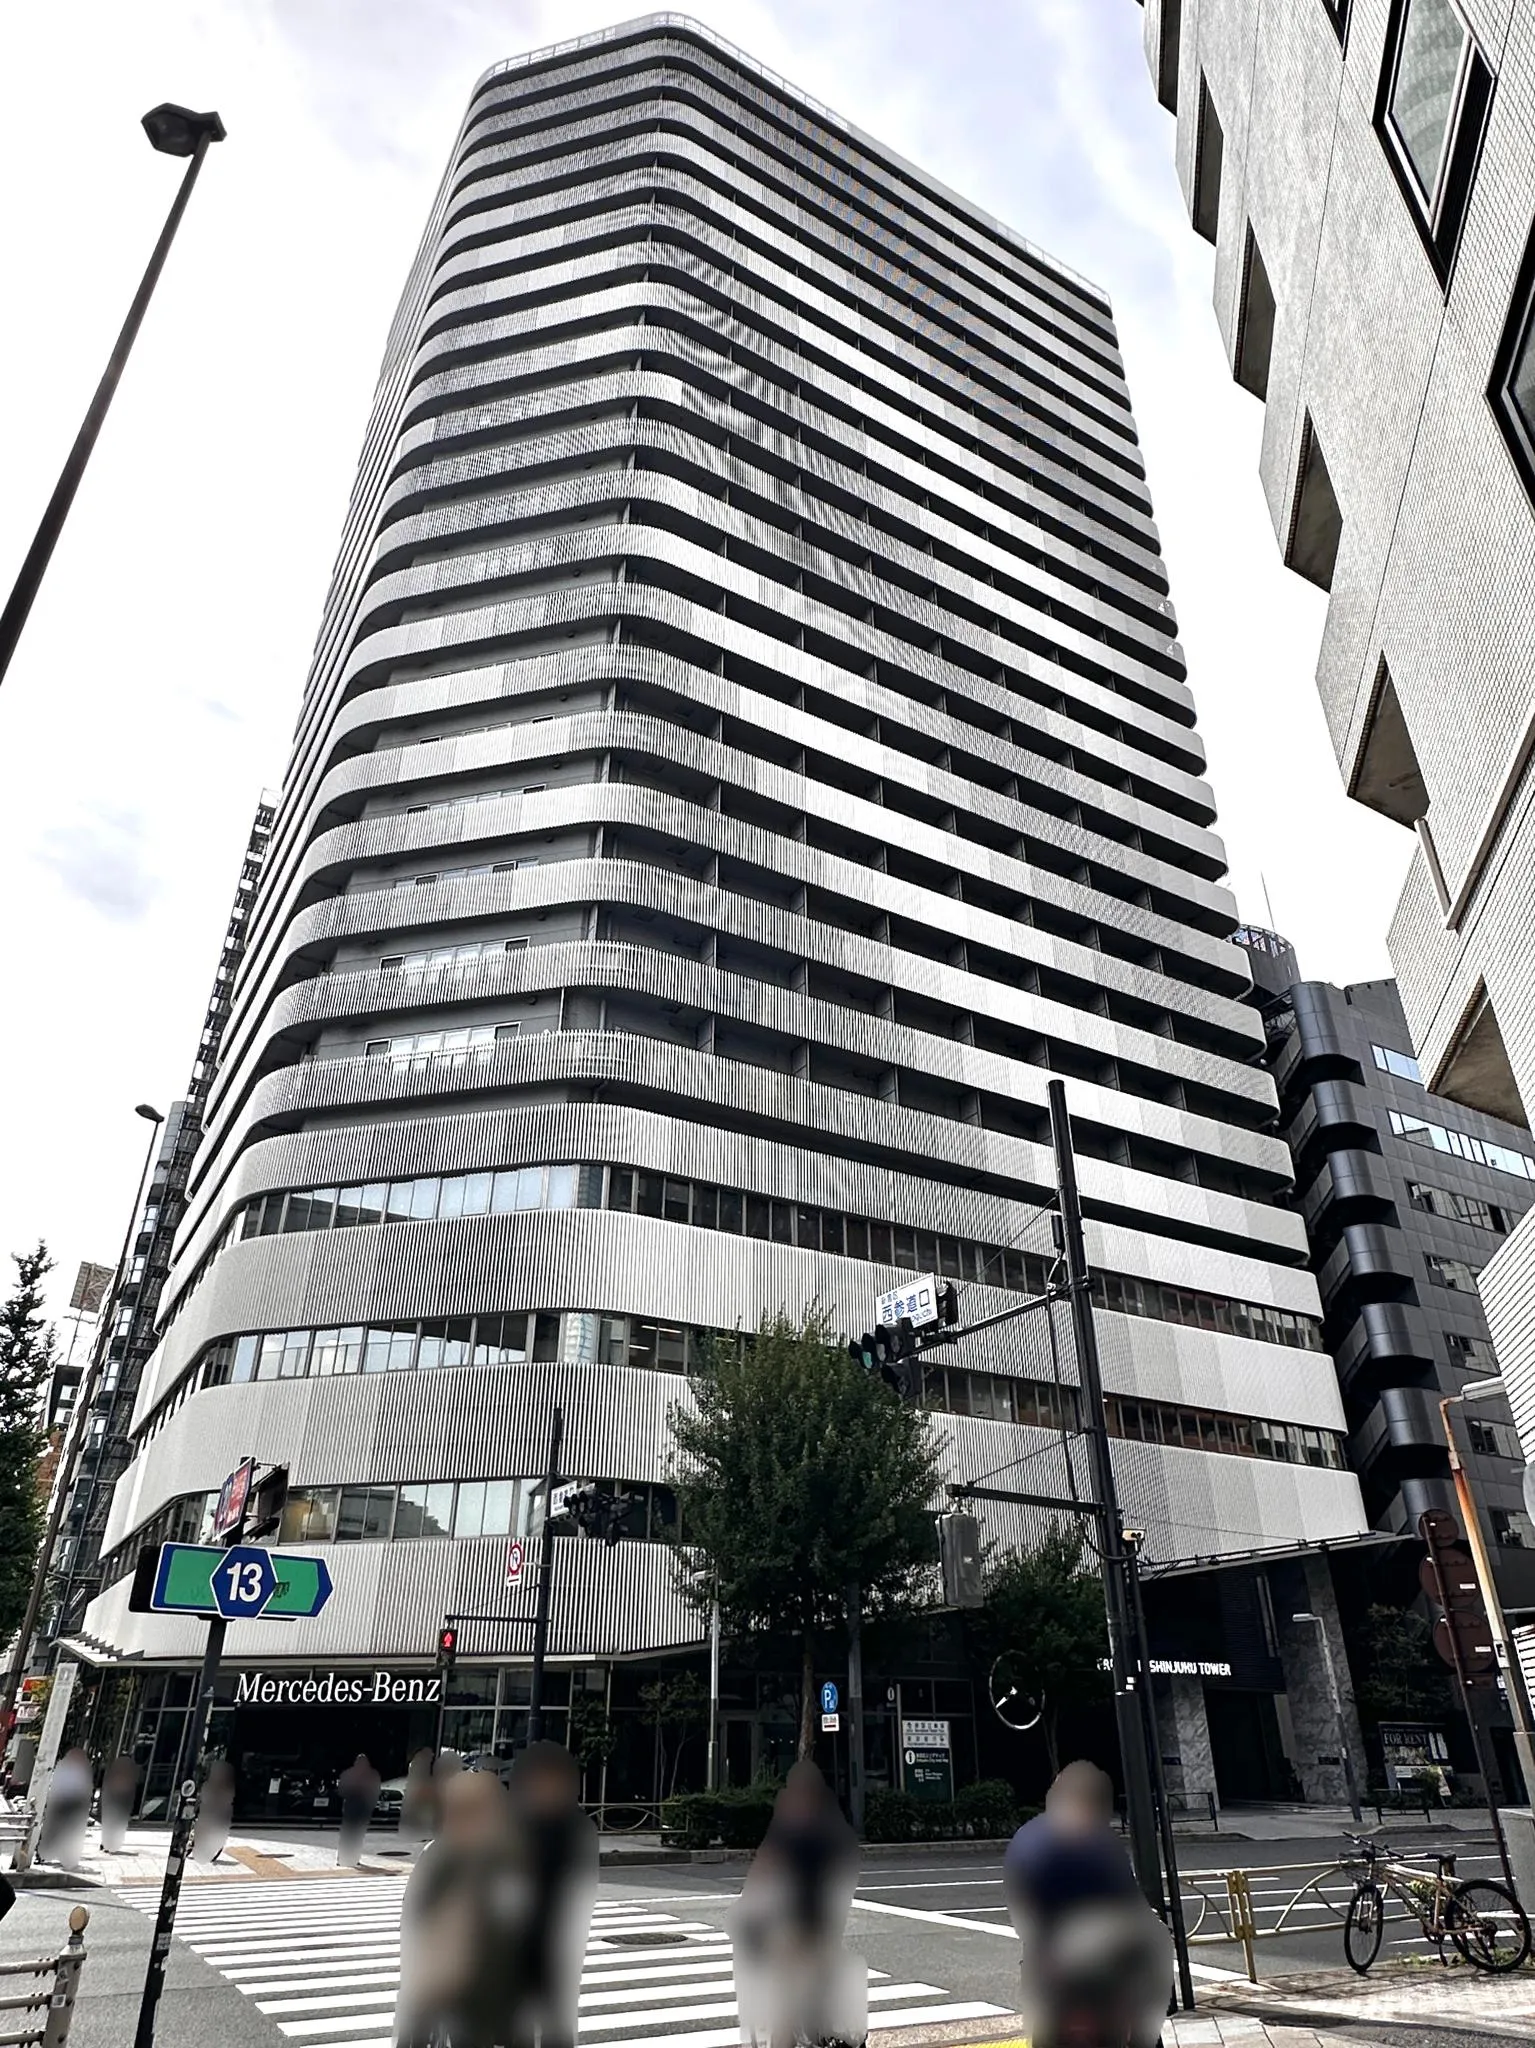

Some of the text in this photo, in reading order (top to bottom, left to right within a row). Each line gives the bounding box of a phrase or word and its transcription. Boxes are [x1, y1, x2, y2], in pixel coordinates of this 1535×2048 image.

[881, 1288, 931, 1323] 西参道口
[226, 1561, 264, 1602] 13
[1149, 1660, 1197, 1675] SHINJUKU
[1198, 1662, 1231, 1676] TOWER
[233, 1671, 441, 1703] Mercedes-Benz
[824, 1690, 832, 1709] P
